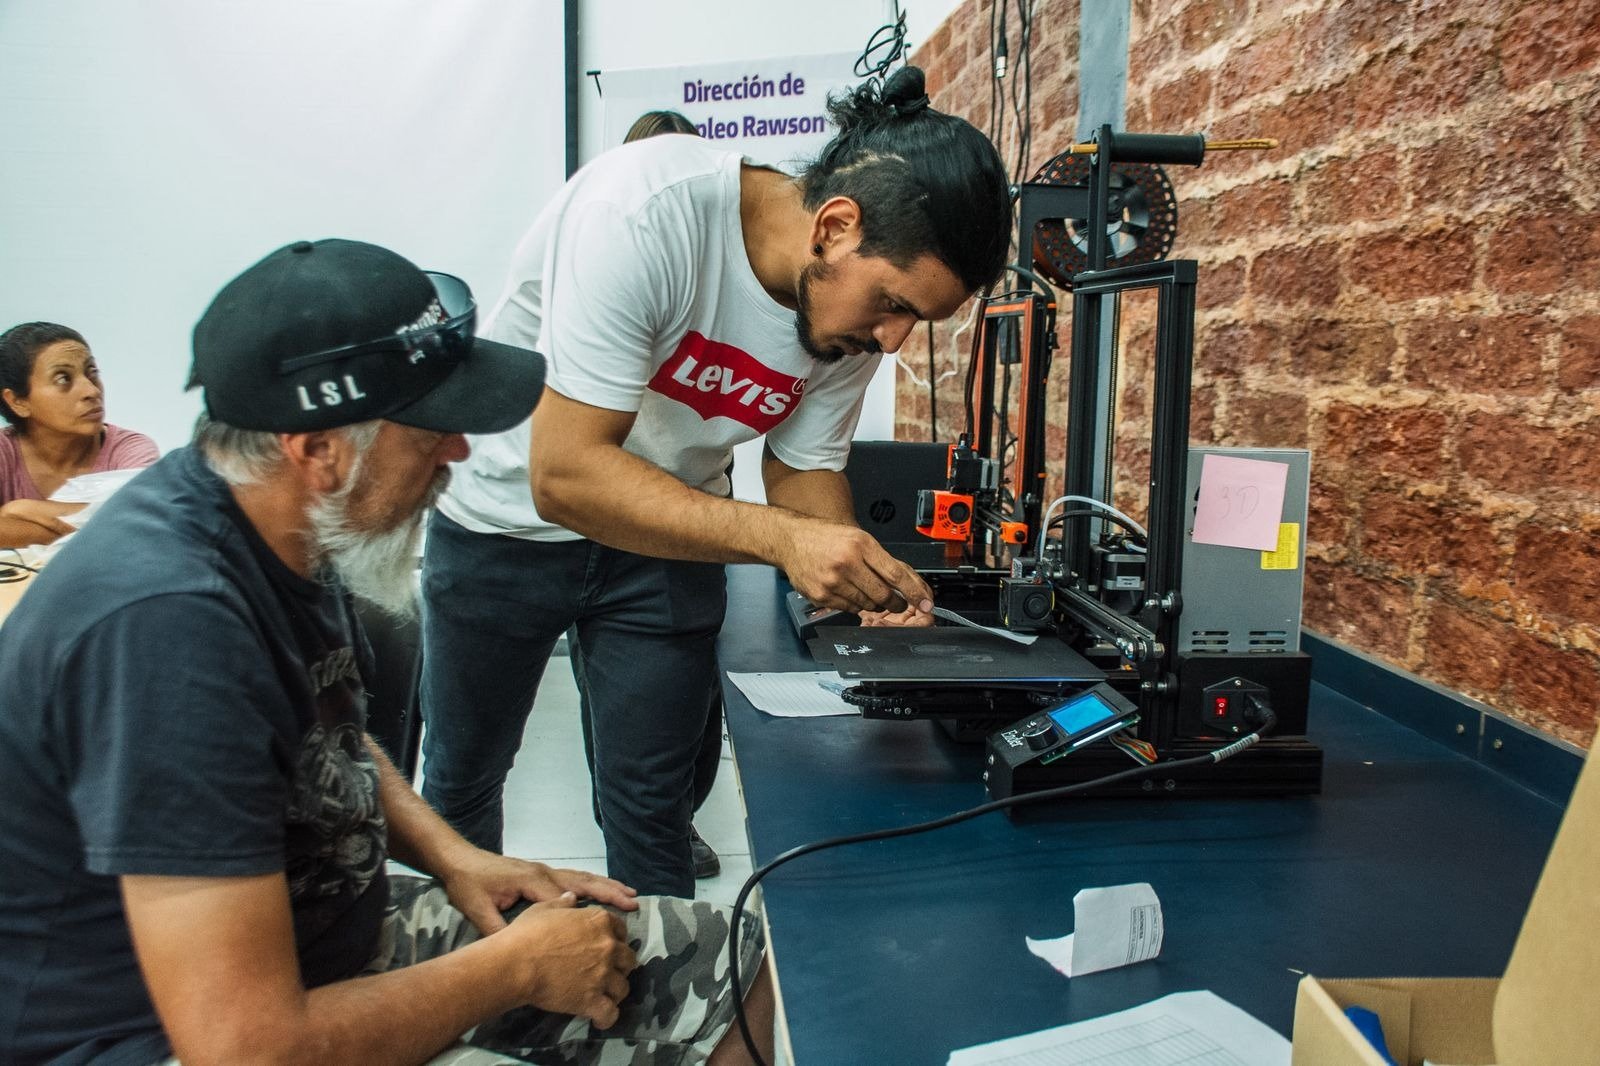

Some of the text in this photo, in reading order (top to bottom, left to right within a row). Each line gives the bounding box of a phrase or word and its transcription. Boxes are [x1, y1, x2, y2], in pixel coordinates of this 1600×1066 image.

[683, 72, 805, 103] Dirección de
[743, 115, 826, 138] Rawson
